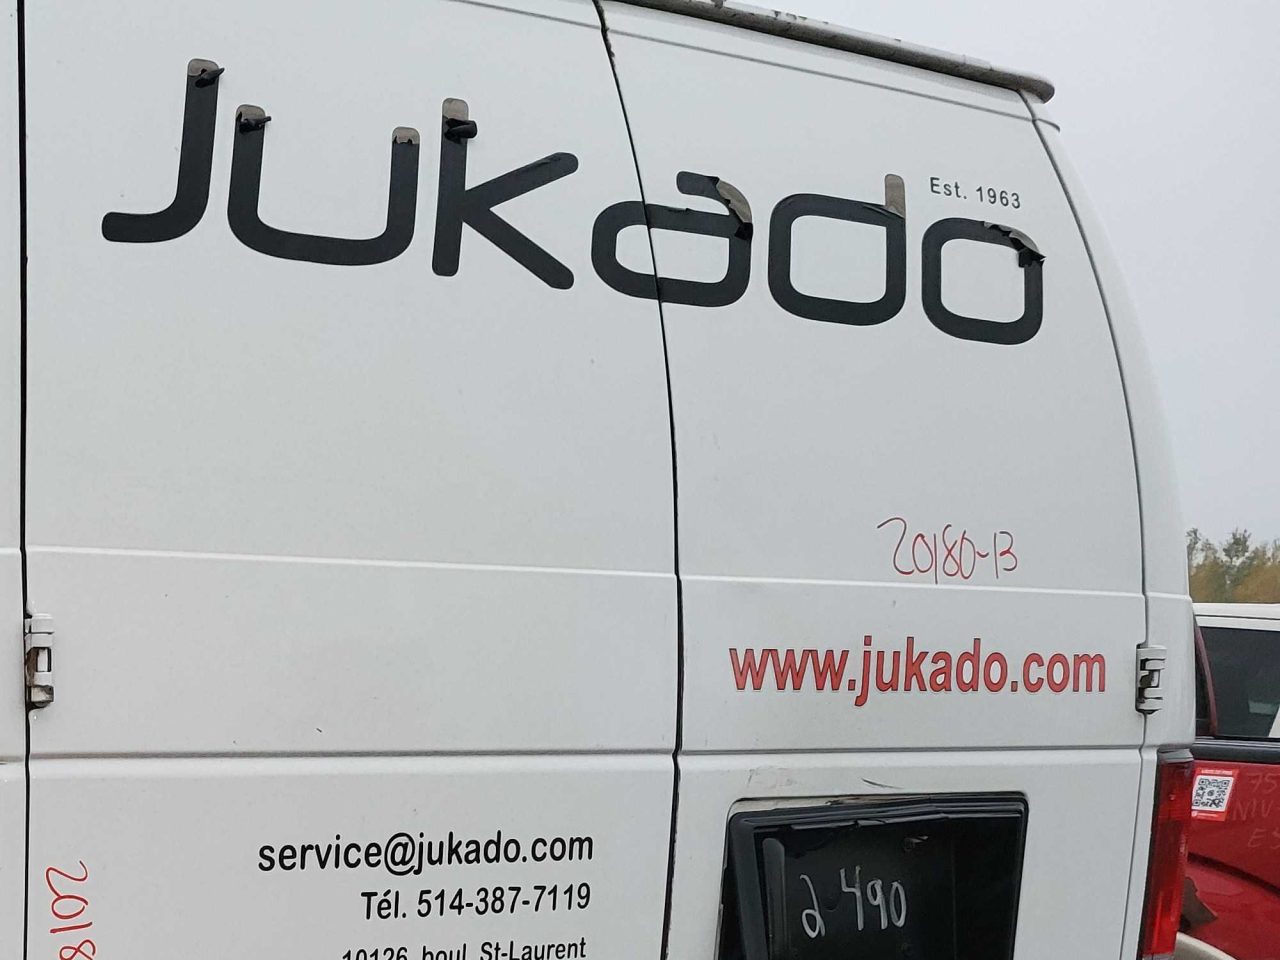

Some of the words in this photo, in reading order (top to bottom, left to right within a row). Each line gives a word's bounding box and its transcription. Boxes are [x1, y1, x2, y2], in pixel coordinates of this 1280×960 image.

[929, 176, 968, 200] Est.
[975, 185, 1021, 210] 1963
[728, 635, 1106, 707] www.jukado.com
[257, 830, 594, 876] service@jukado.com
[360, 888, 407, 920] Tél.
[417, 882, 591, 918] 514-387-7119
